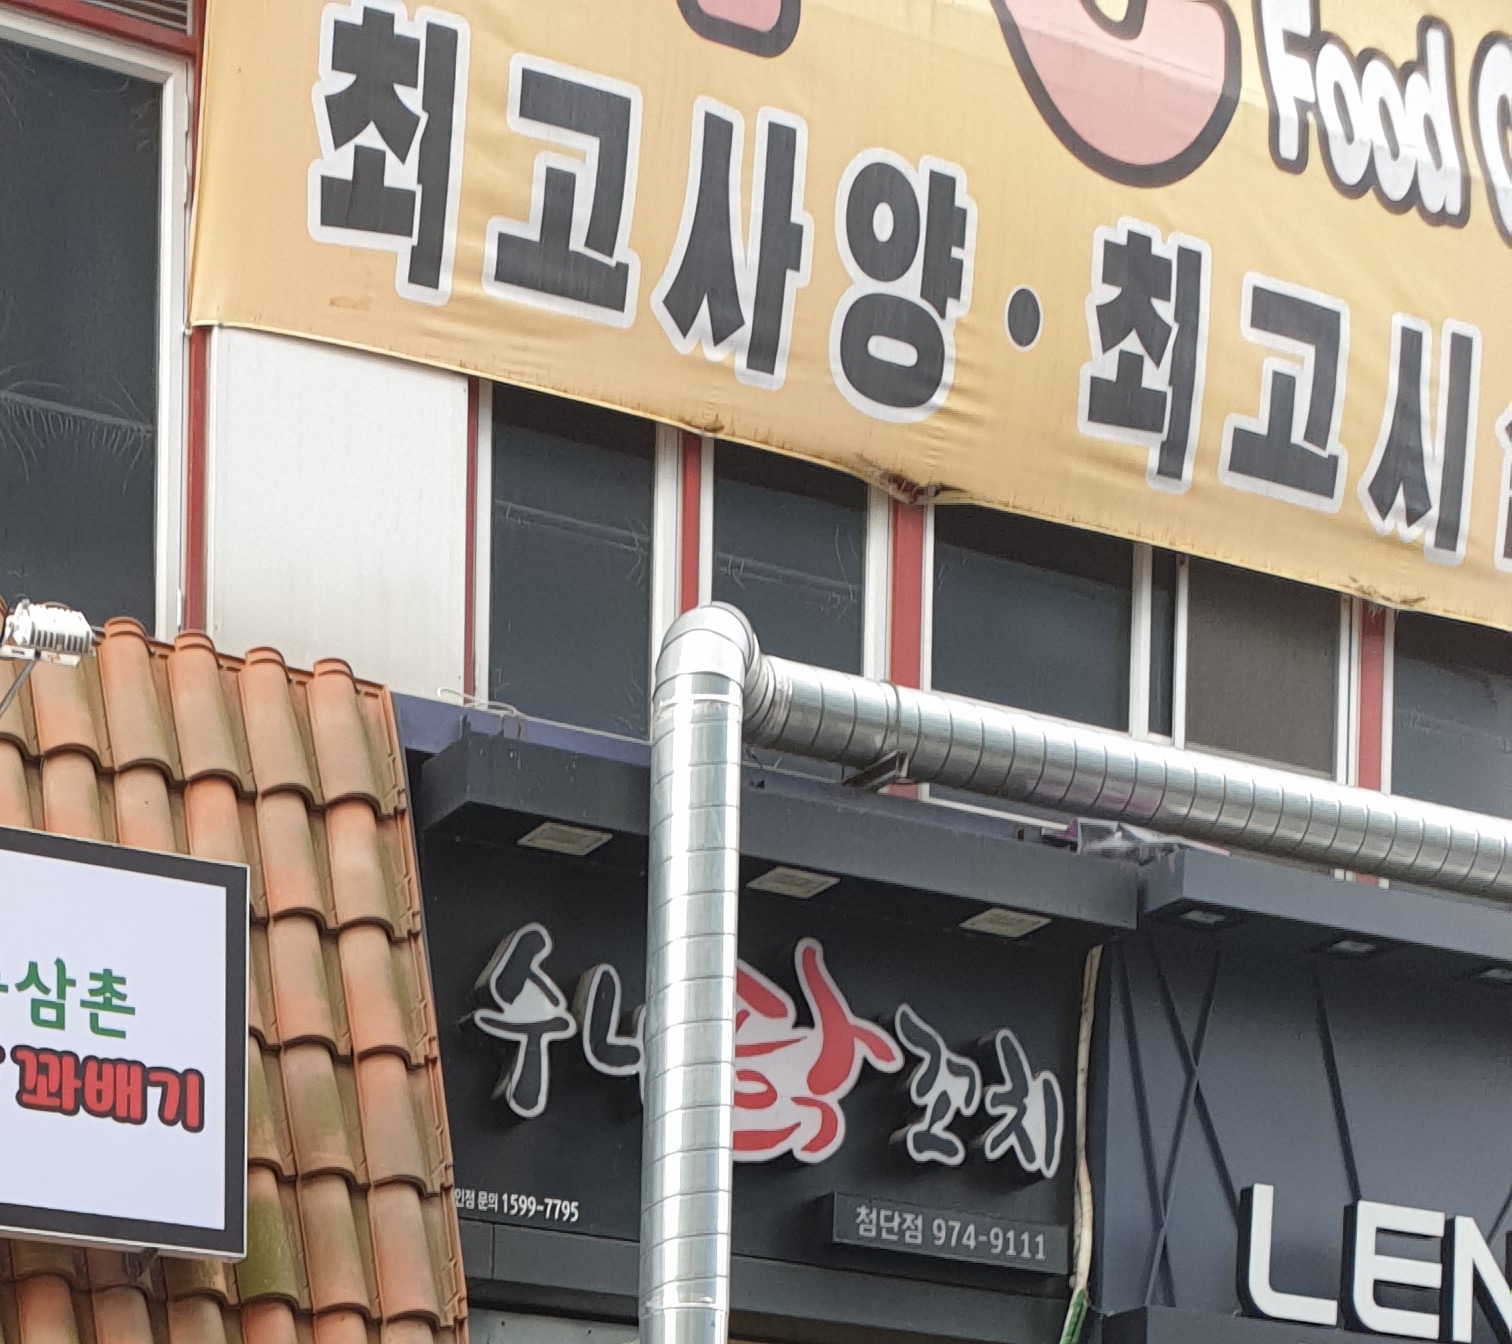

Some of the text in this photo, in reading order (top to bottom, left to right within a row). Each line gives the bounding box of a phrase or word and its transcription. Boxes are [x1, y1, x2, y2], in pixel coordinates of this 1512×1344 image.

[1256, 0, 1467, 229] Food
[312, 3, 1512, 572] 최고사양 최고시
[11, 1045, 204, 1133] 꽈배기
[478, 1191, 498, 1213] 문의
[502, 1193, 579, 1222] 1599-7795
[855, 1204, 1047, 1263] 첨단점 974-9111
